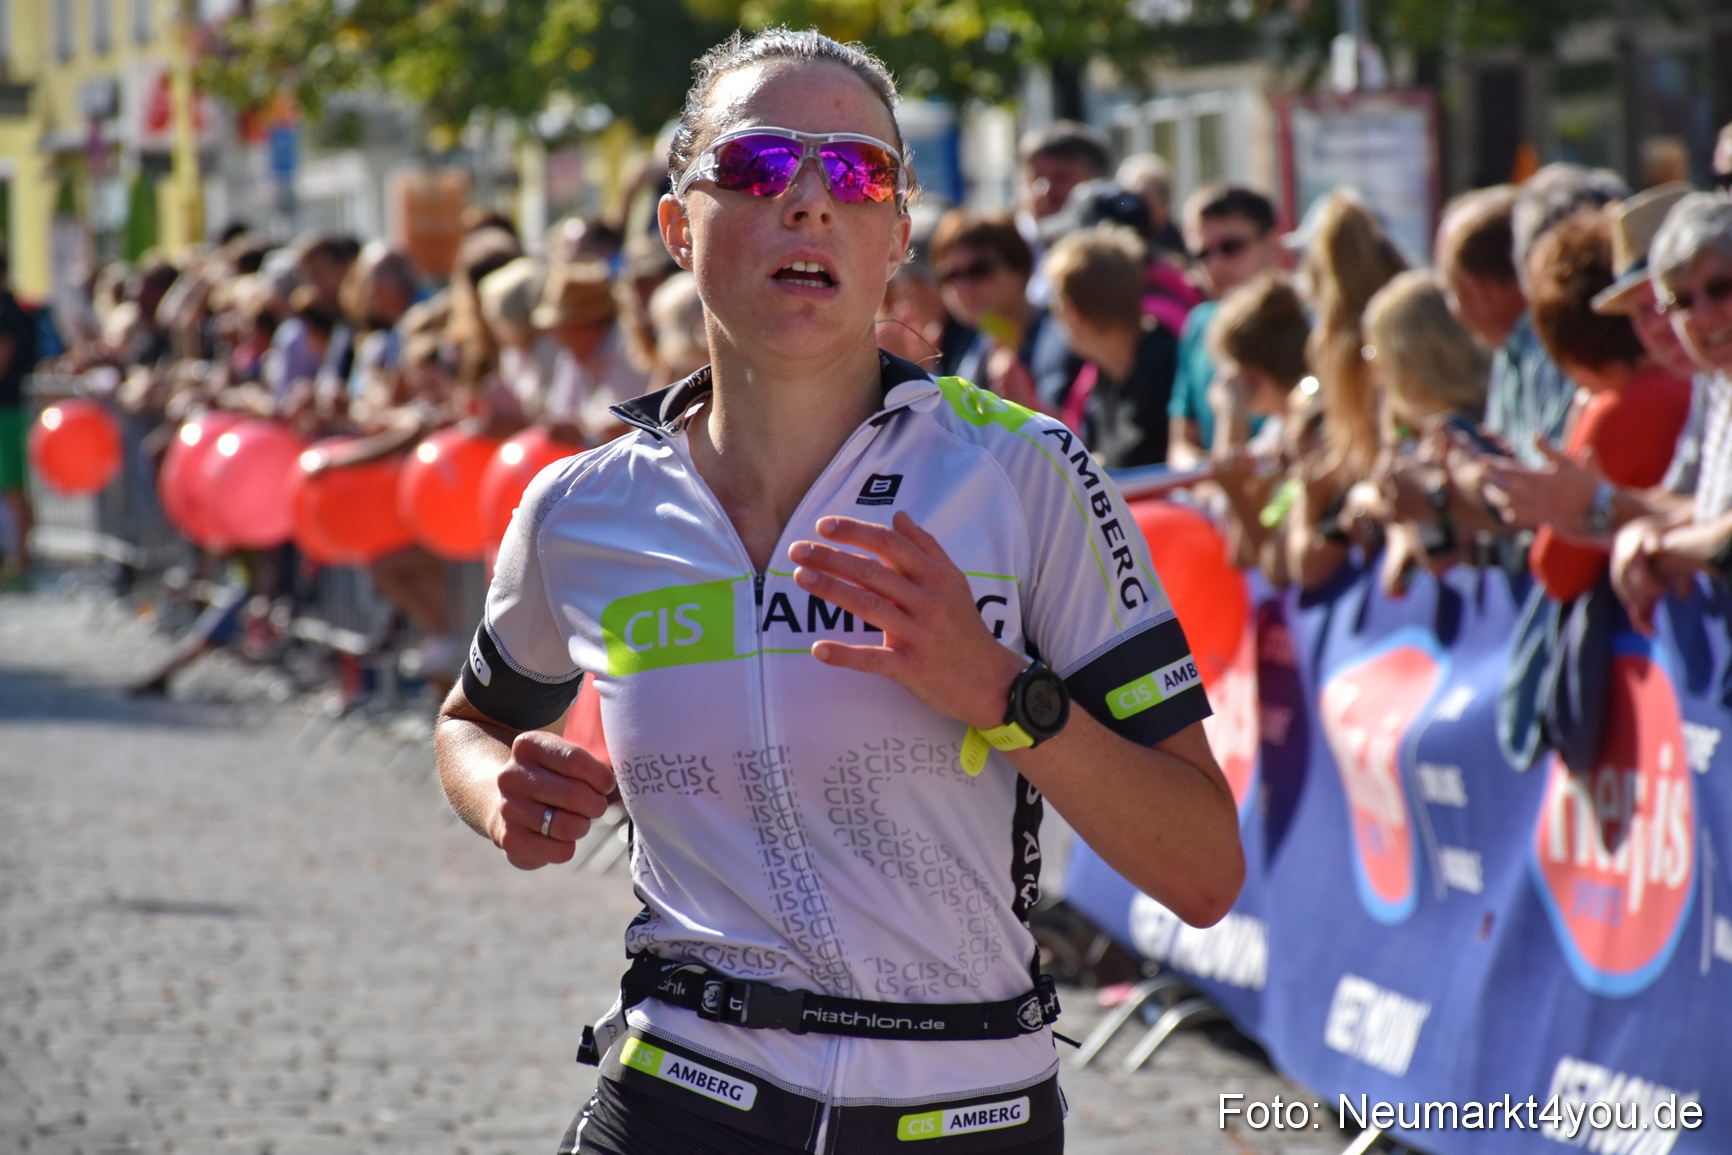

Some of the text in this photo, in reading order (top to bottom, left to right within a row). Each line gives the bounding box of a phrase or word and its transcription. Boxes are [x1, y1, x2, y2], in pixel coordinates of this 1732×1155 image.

[1042, 427, 1149, 610] AMBERG
[624, 603, 703, 652] CIS
[1119, 684, 1152, 709] CIS
[910, 744, 948, 763] CIS
[635, 760, 662, 782] CIS
[666, 766, 701, 788] CIS
[865, 755, 907, 773] CIS
[823, 788, 865, 805] CIS
[828, 808, 868, 825] CIS
[877, 839, 915, 857] CIS
[880, 860, 918, 879] CIS
[902, 962, 939, 982] CIS
[628, 1046, 744, 1101] CIS AMBERG
[908, 1104, 1020, 1135] CIS AMBERG
